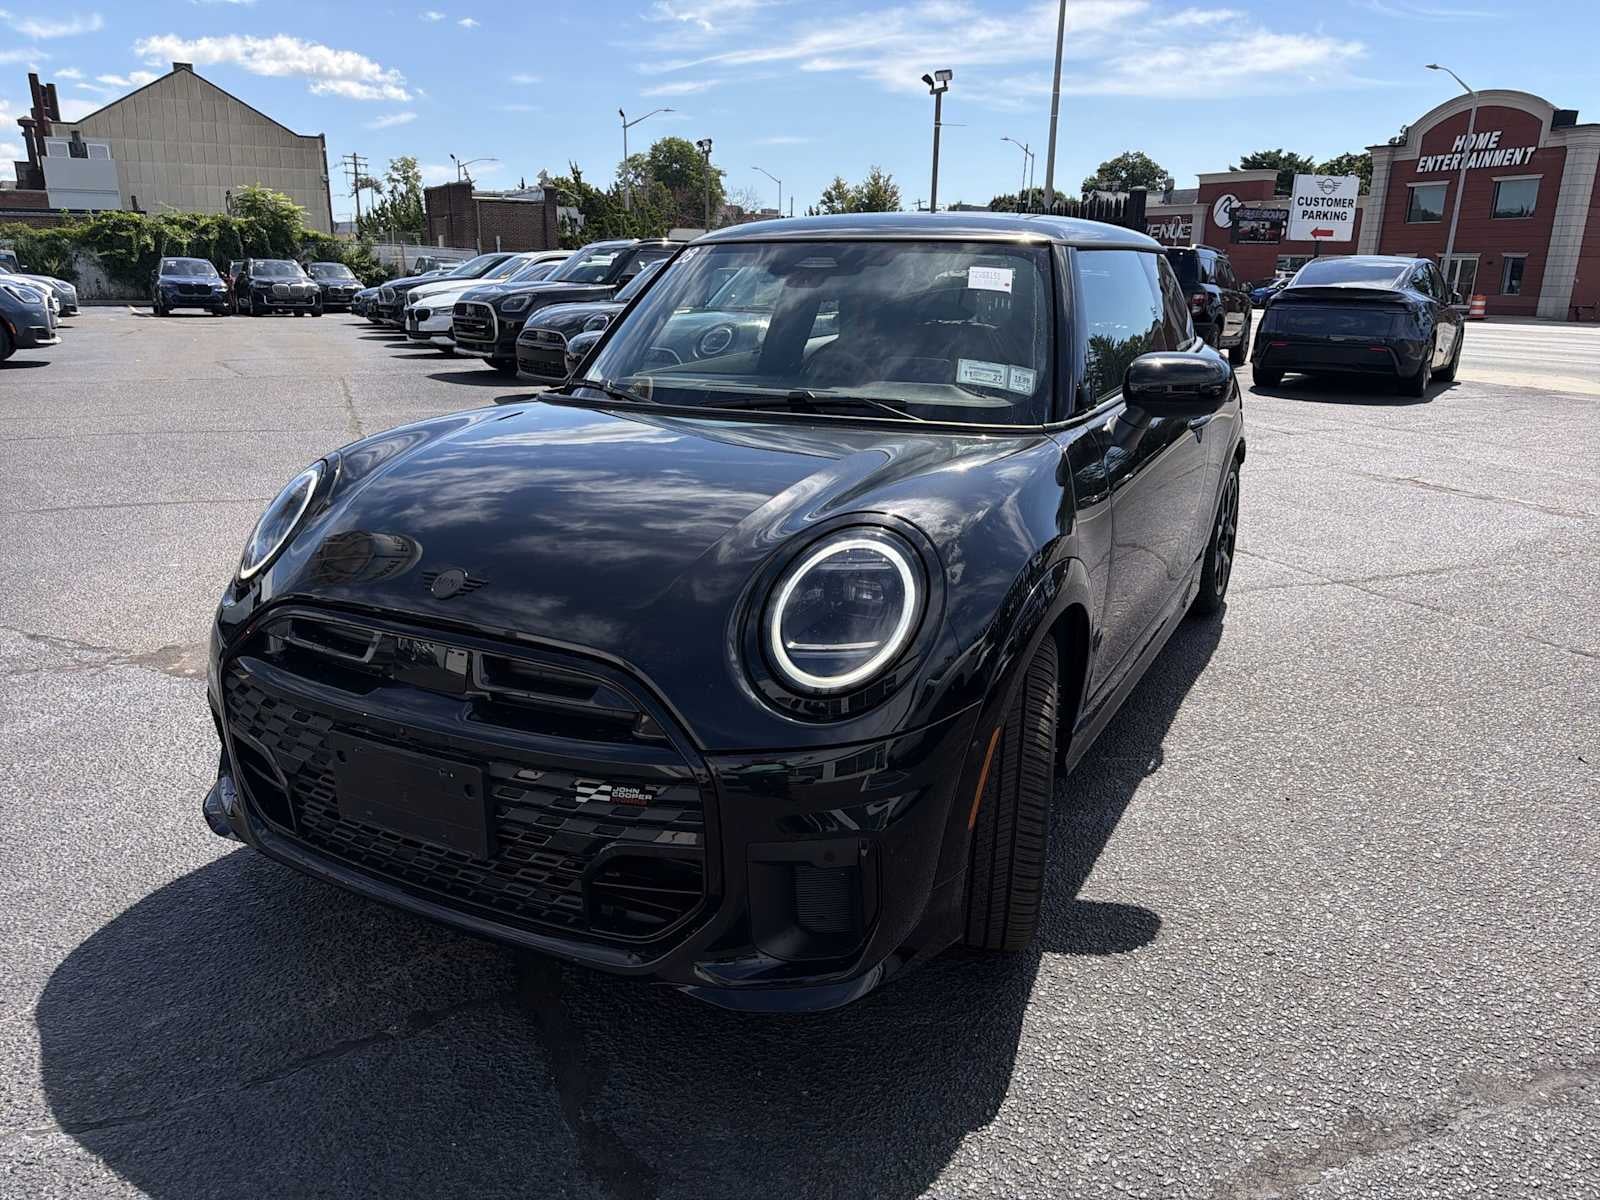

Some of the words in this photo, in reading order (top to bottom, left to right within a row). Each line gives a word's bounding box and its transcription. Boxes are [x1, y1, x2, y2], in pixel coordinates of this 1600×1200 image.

[1451, 131, 1502, 153] HOME
[1297, 196, 1354, 208] CUSTOMER
[1302, 209, 1348, 221] PARKING
[612, 786, 640, 794] JOHN
[612, 791, 652, 800] COOPER
